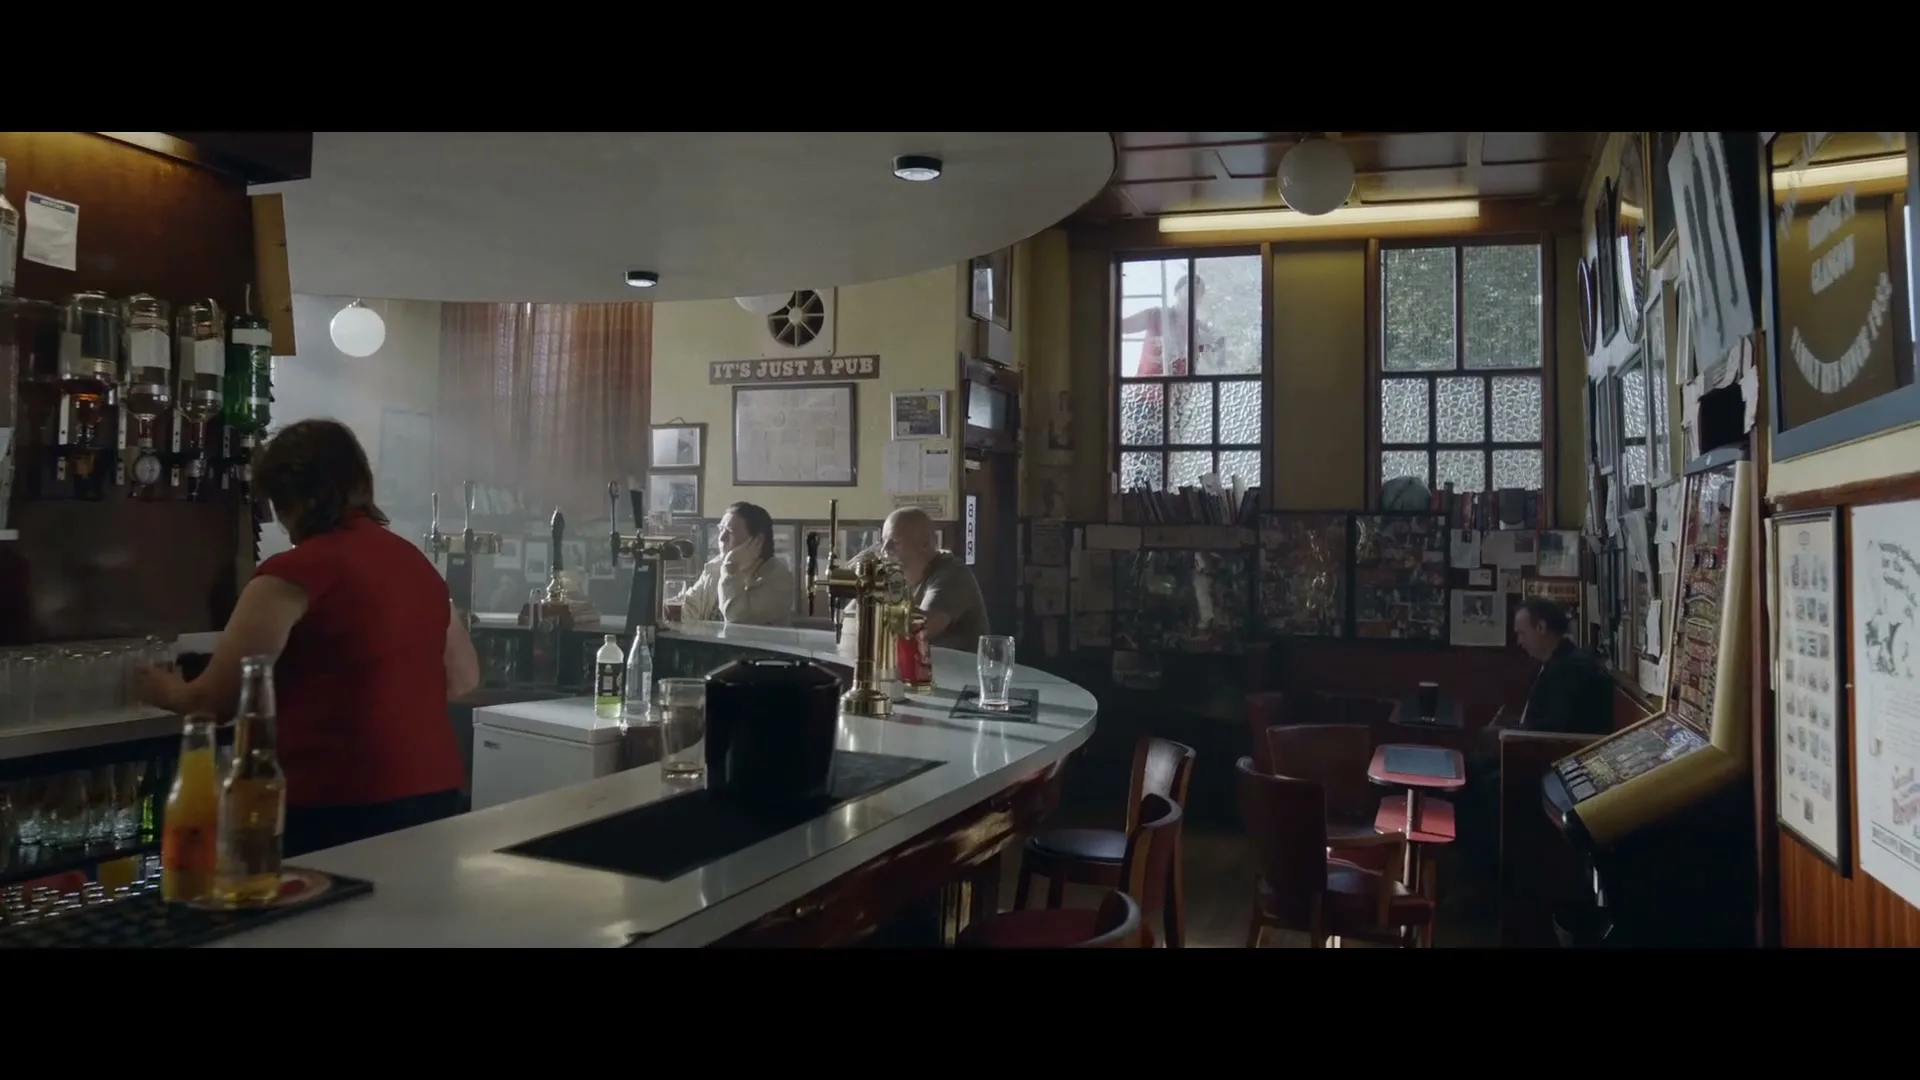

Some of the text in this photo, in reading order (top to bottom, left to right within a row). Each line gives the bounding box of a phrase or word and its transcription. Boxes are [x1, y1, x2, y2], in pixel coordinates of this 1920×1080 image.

[713, 356, 874, 379] IT'S JUST A PUB
